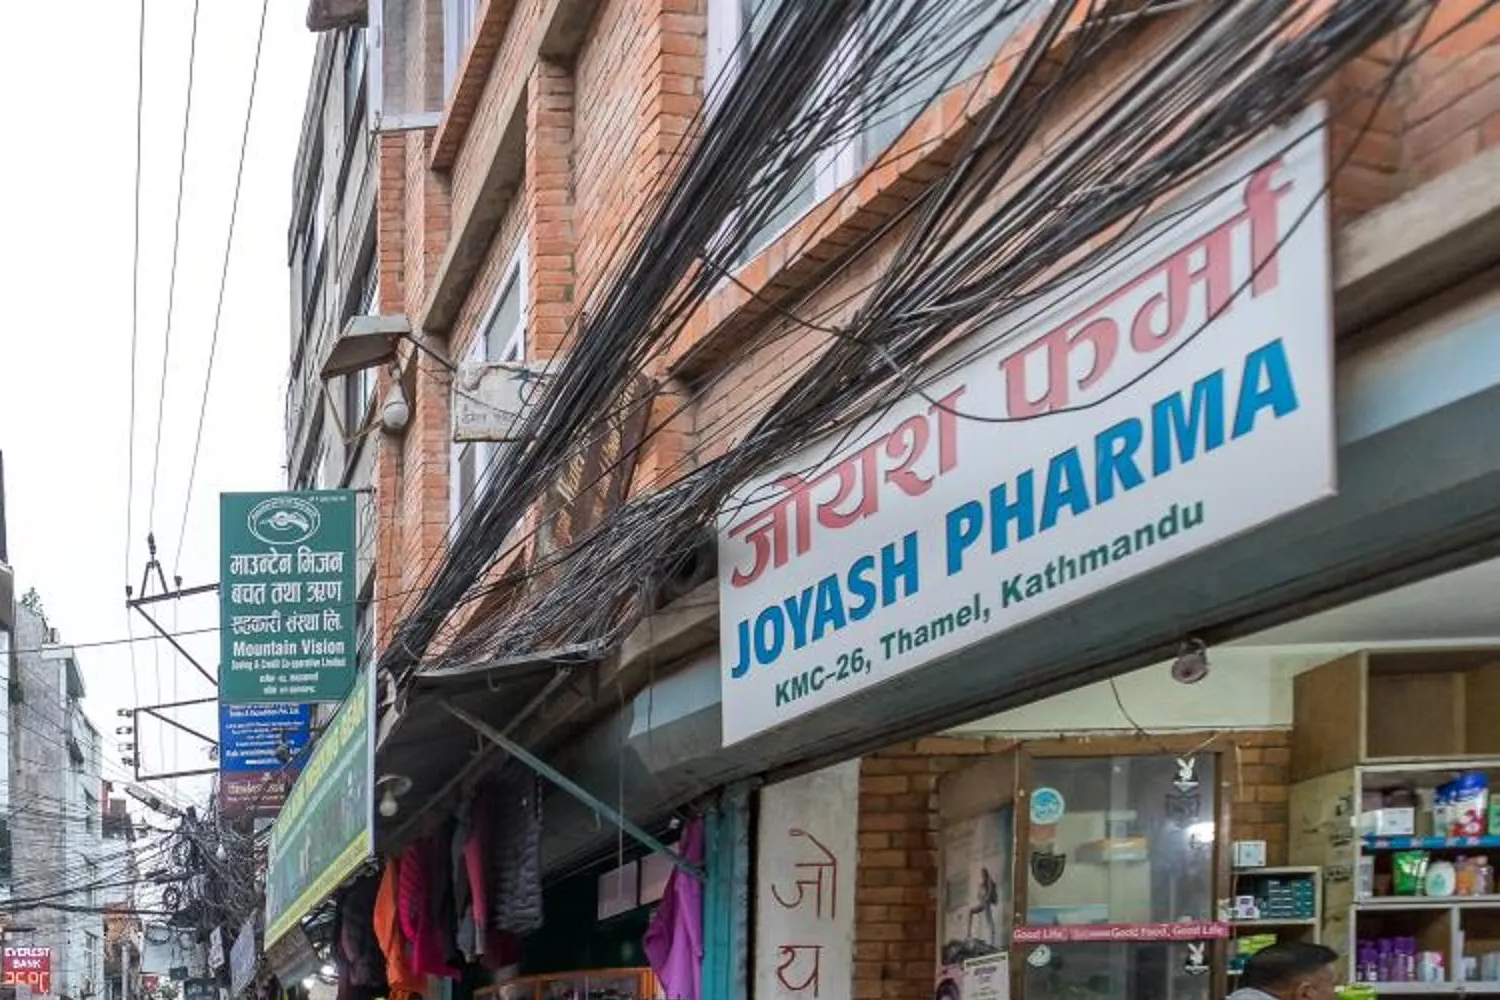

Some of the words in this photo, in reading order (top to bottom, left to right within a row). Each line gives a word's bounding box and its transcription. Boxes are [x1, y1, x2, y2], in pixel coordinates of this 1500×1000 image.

[731, 531, 920, 680] JOYASH
[945, 337, 1300, 577] PHARMA
[231, 583, 267, 604] बचत
[270, 582, 302, 603] तथा
[774, 647, 872, 708] KMC-26,
[880, 590, 991, 662] Thamel,
[1000, 501, 1205, 609] Kathmandu
[233, 639, 297, 656] Mountain
[301, 638, 345, 655] Vision
[13, 958, 41, 969] BANK
